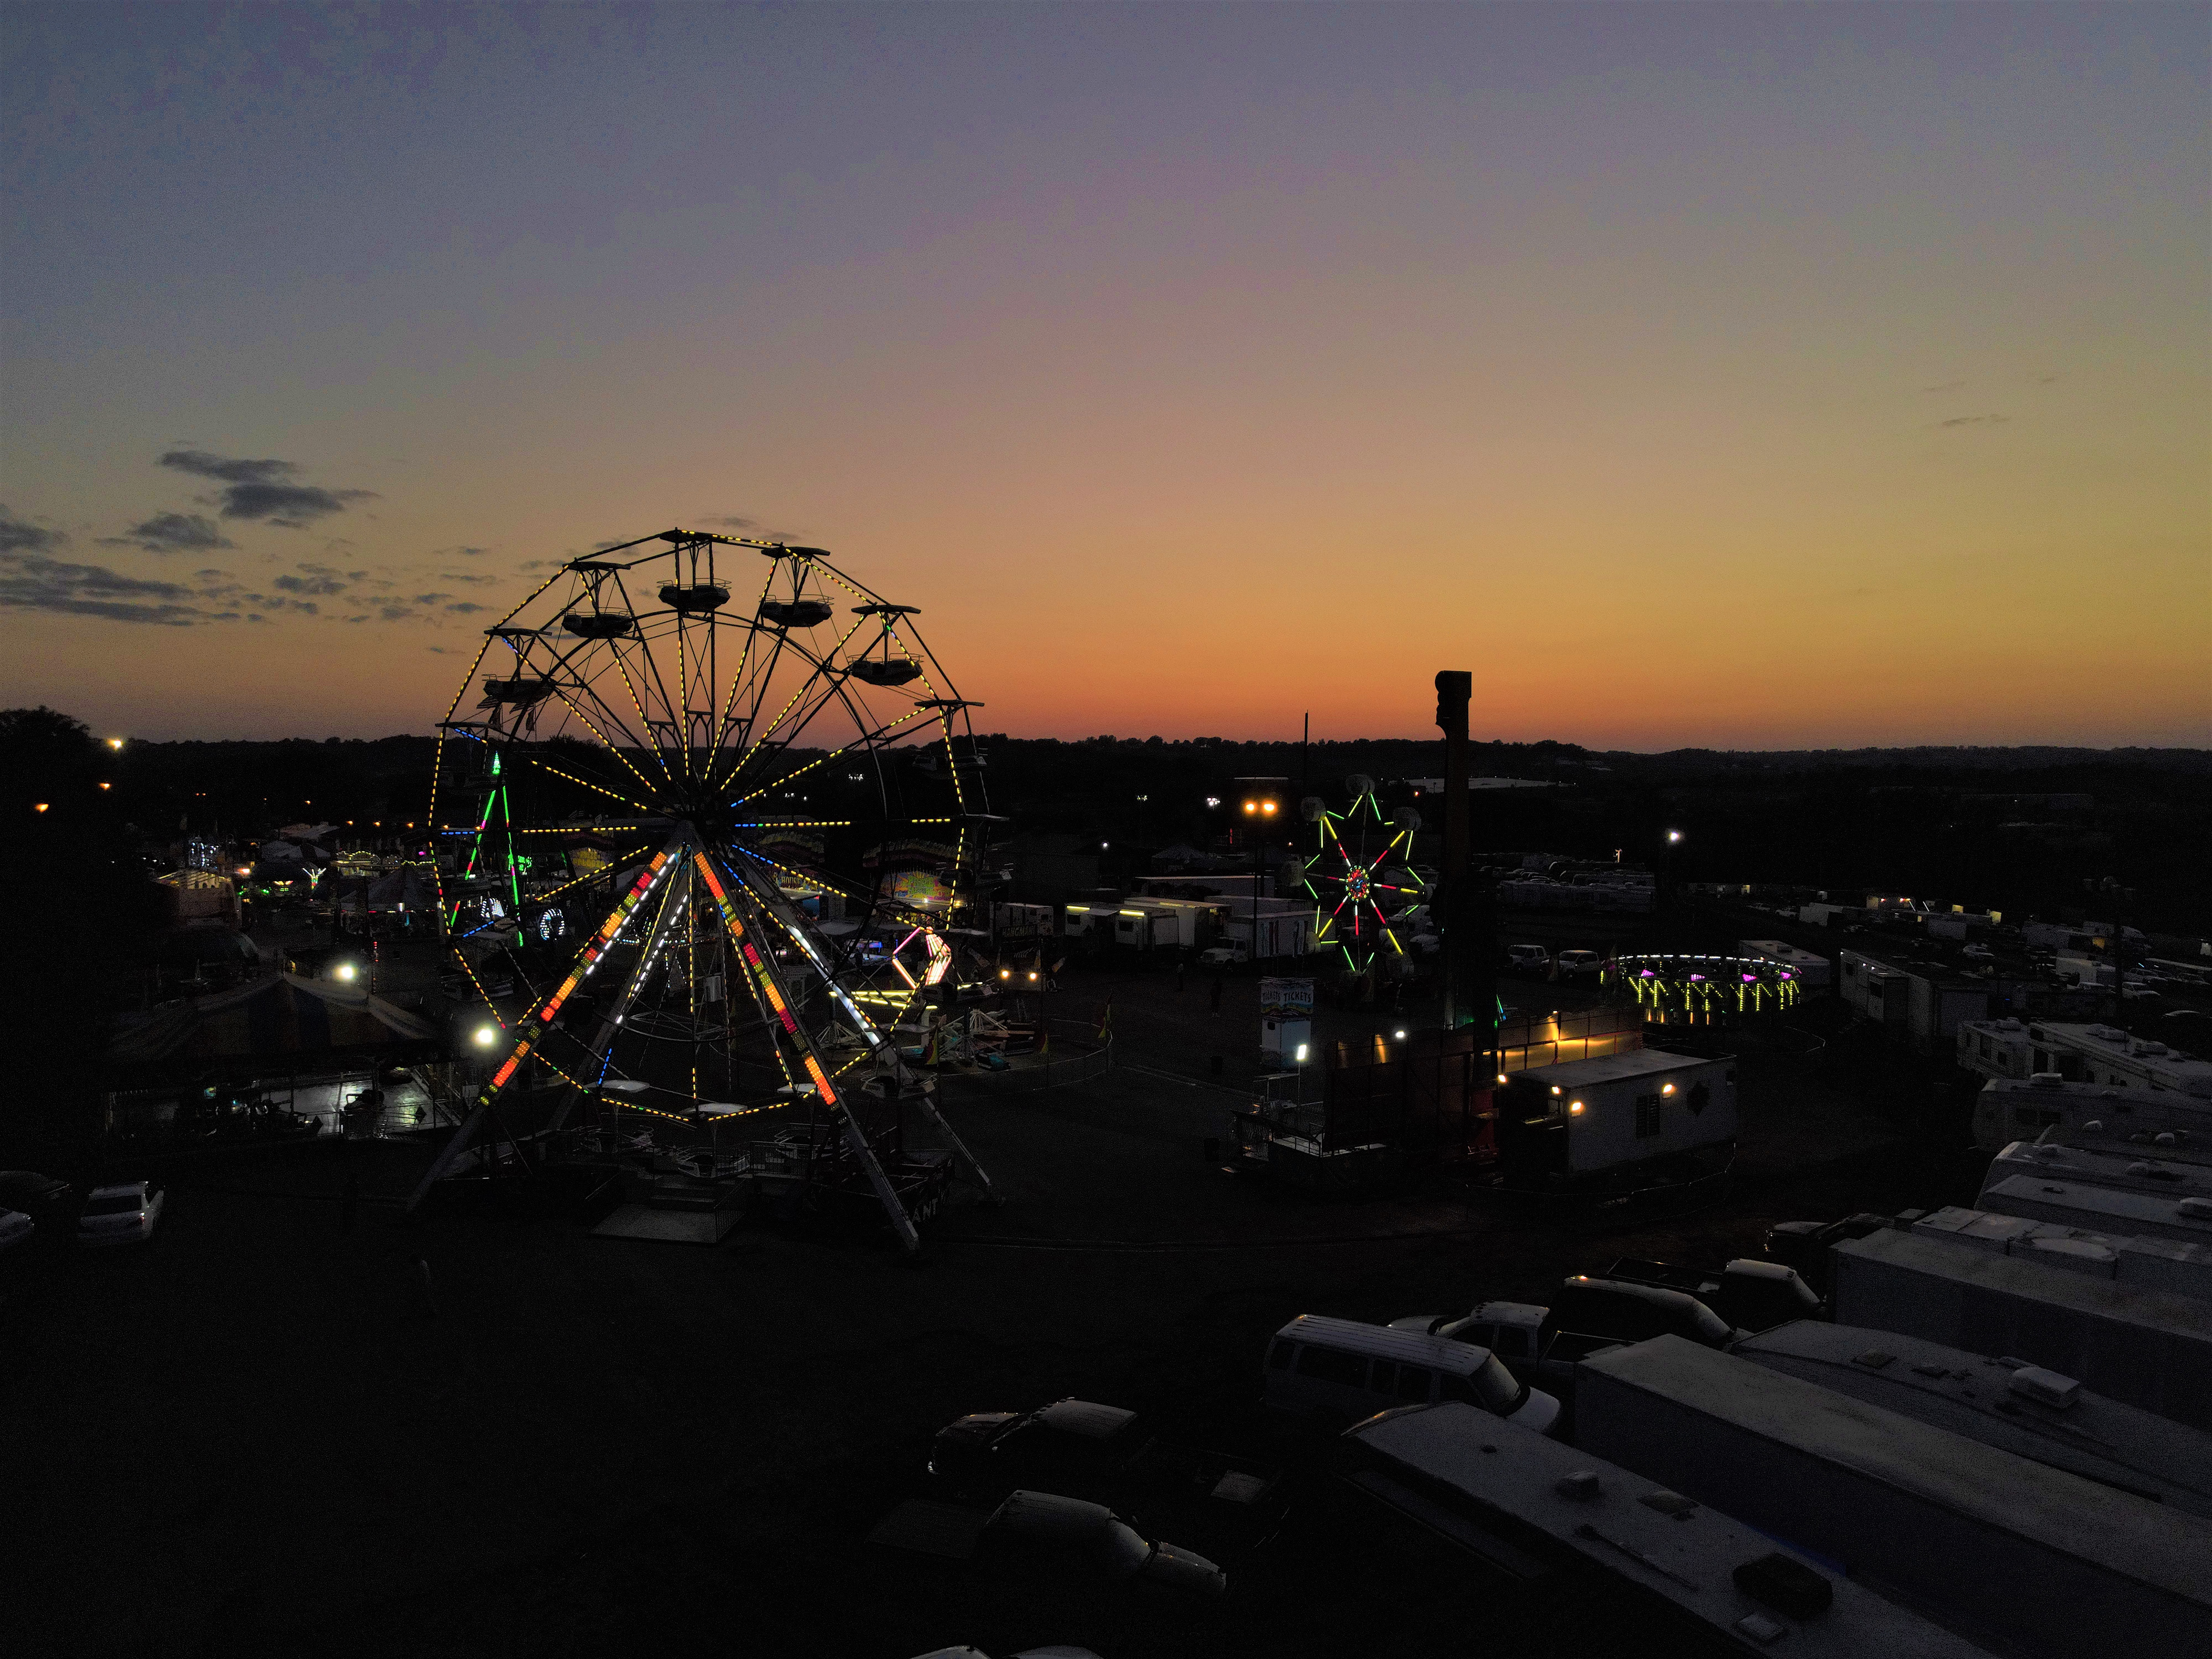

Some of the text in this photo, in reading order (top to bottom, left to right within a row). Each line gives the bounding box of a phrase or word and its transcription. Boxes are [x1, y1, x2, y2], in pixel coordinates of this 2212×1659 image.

[781, 876, 800, 885] HOUSE
[1262, 991, 1280, 1002] TICKETS
[1283, 991, 1311, 1003] TICKETS
[912, 1198, 938, 1224] ANT
